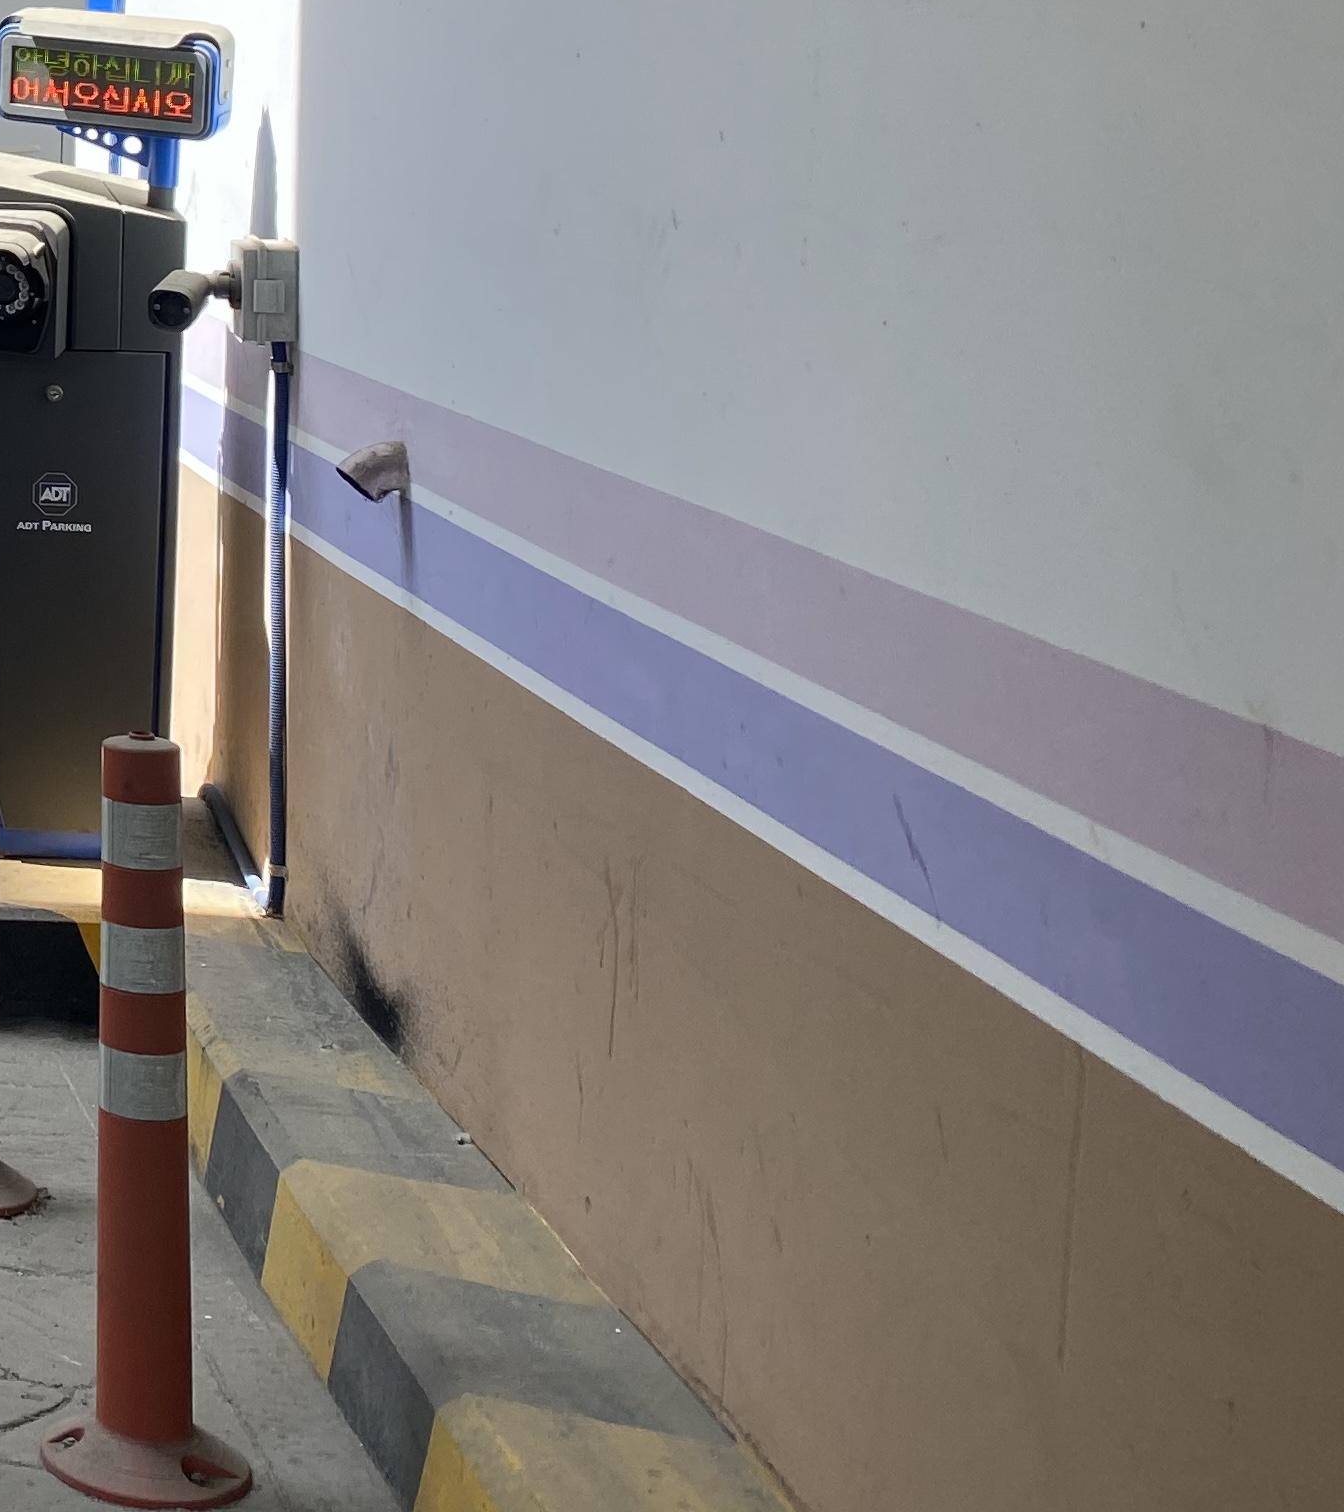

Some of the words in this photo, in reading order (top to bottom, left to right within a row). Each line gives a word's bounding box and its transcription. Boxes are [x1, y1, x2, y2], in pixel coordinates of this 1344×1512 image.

[11, 76, 193, 119] 어서오십시오
[39, 486, 71, 502] ADT
[16, 521, 40, 530] ADT
